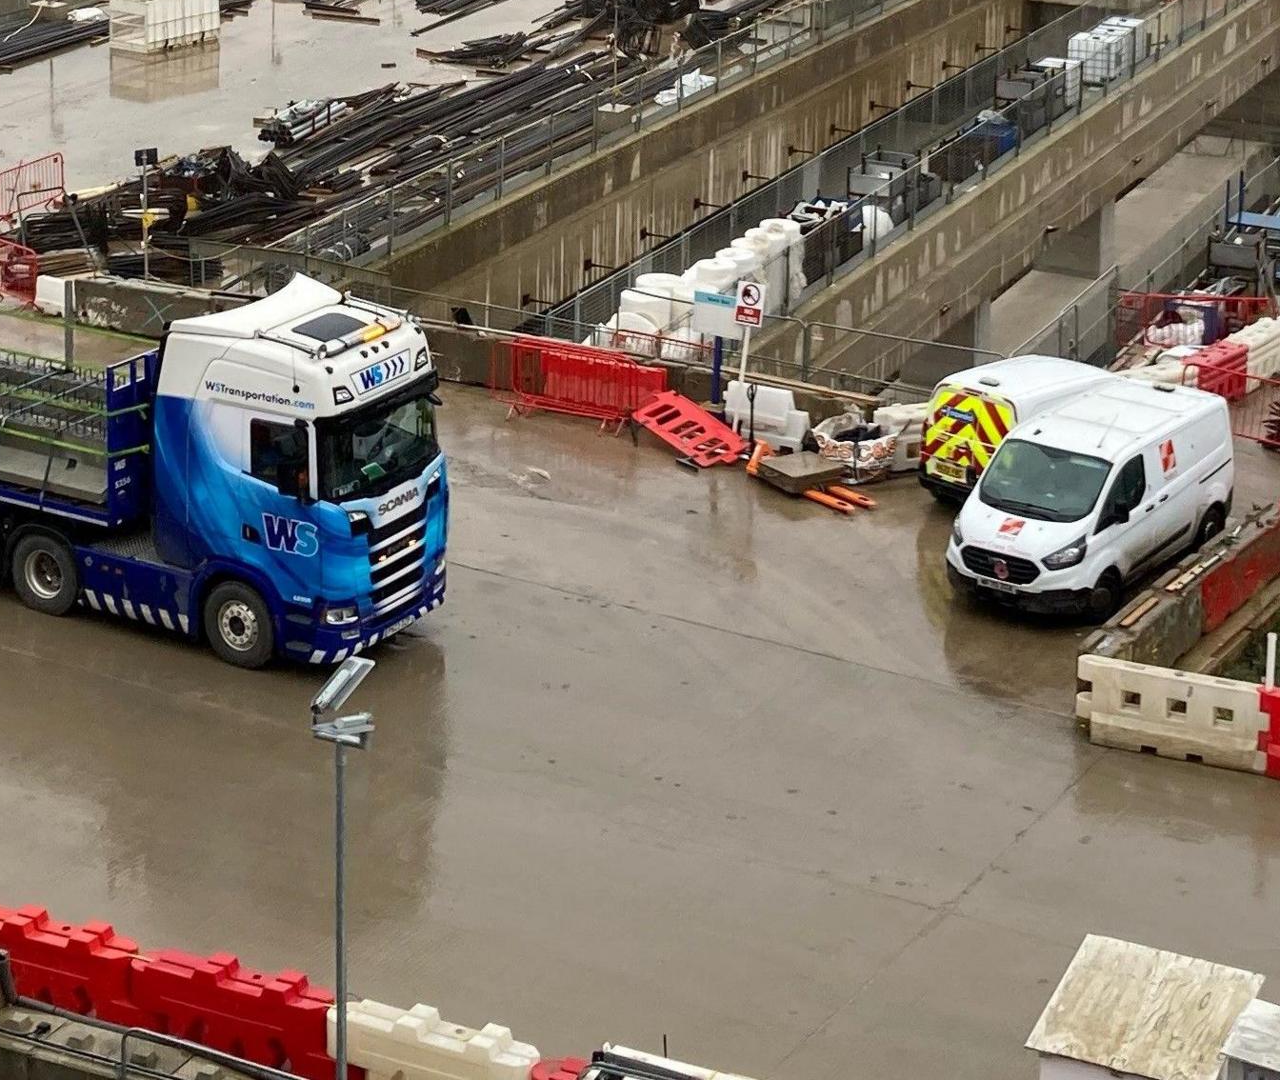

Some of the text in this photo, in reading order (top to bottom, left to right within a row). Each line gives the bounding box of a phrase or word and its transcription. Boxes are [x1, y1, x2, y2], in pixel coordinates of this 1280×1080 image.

[359, 364, 384, 390] WS
[204, 380, 315, 410] WSTransportation.com
[377, 486, 420, 517] SCANIA
[262, 512, 319, 557] WS
